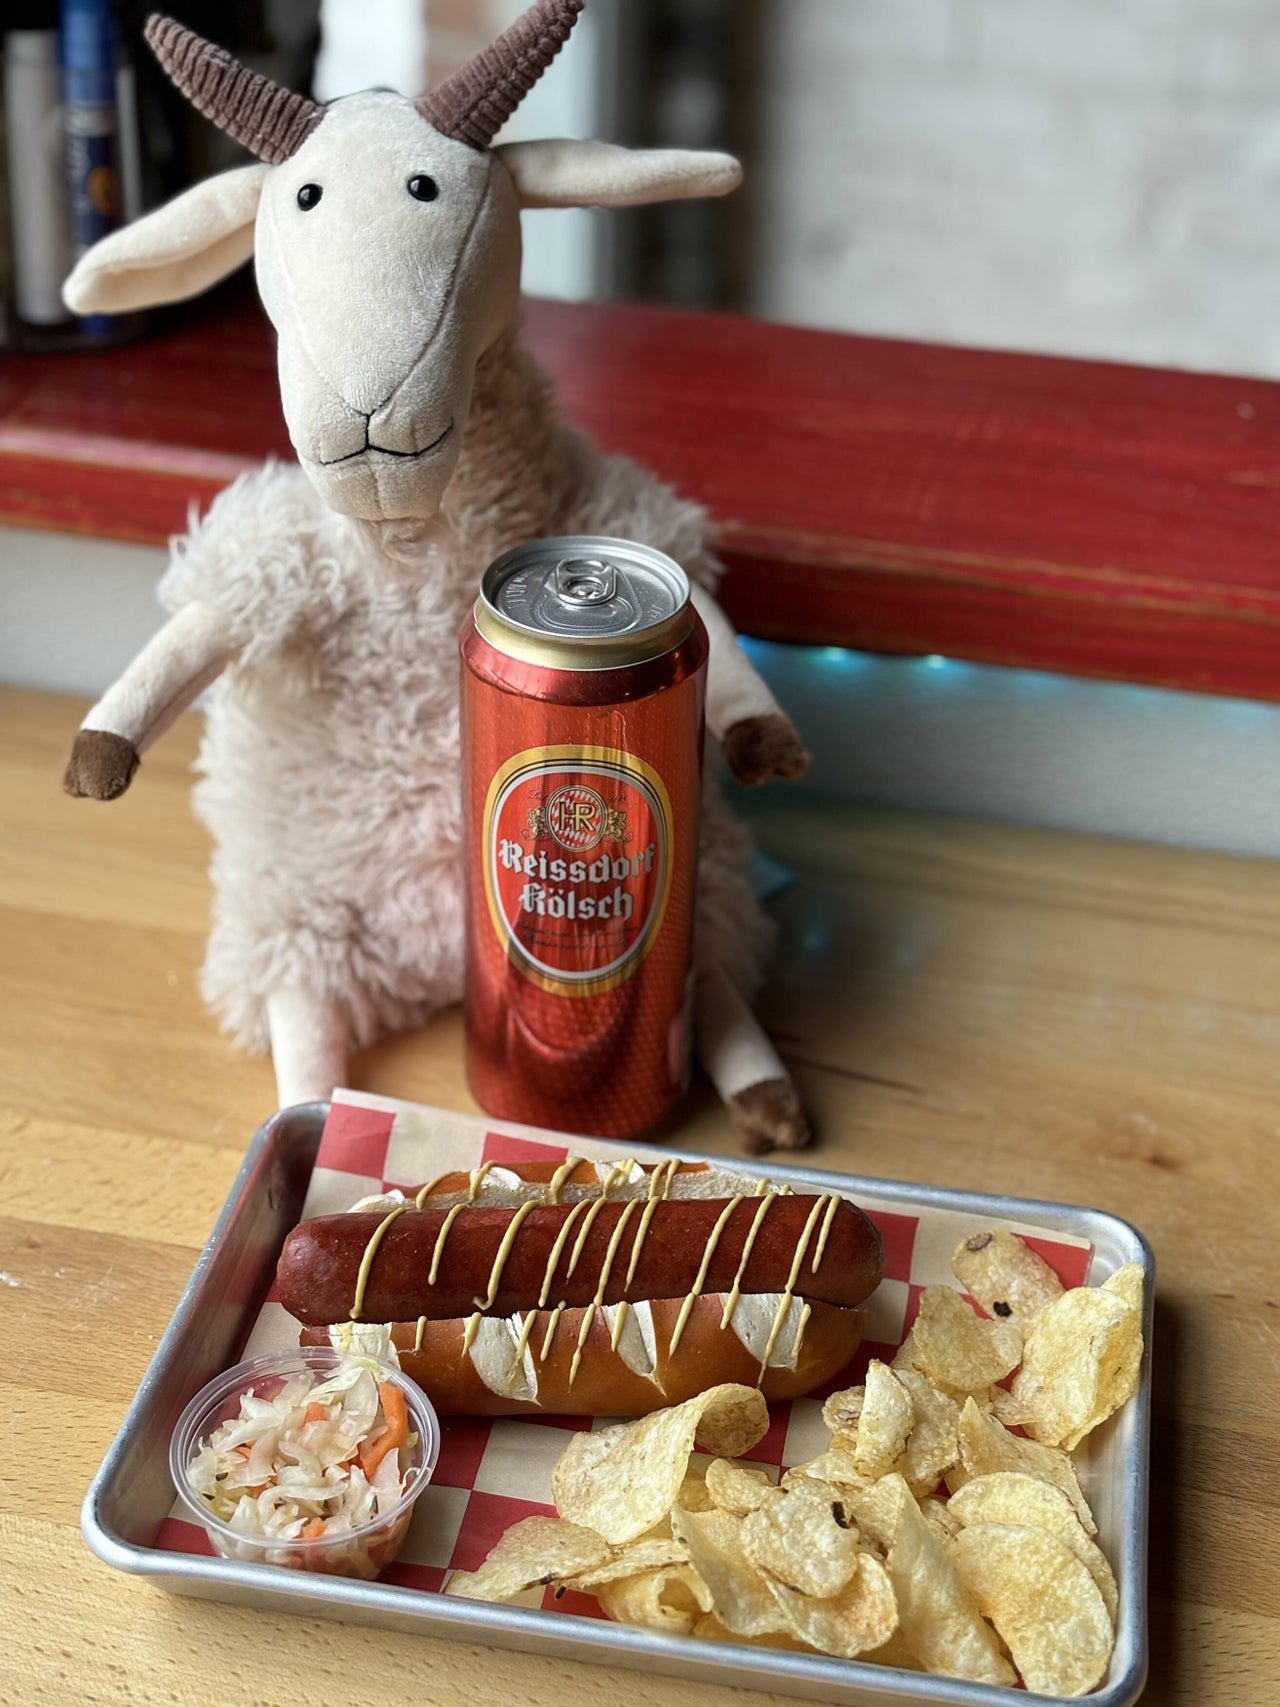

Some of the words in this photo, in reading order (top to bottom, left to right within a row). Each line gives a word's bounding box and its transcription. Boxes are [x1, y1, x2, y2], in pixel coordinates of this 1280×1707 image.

[559, 801, 596, 832] HR
[498, 838, 656, 884] Reissdorf
[518, 882, 634, 921] Kölsch
